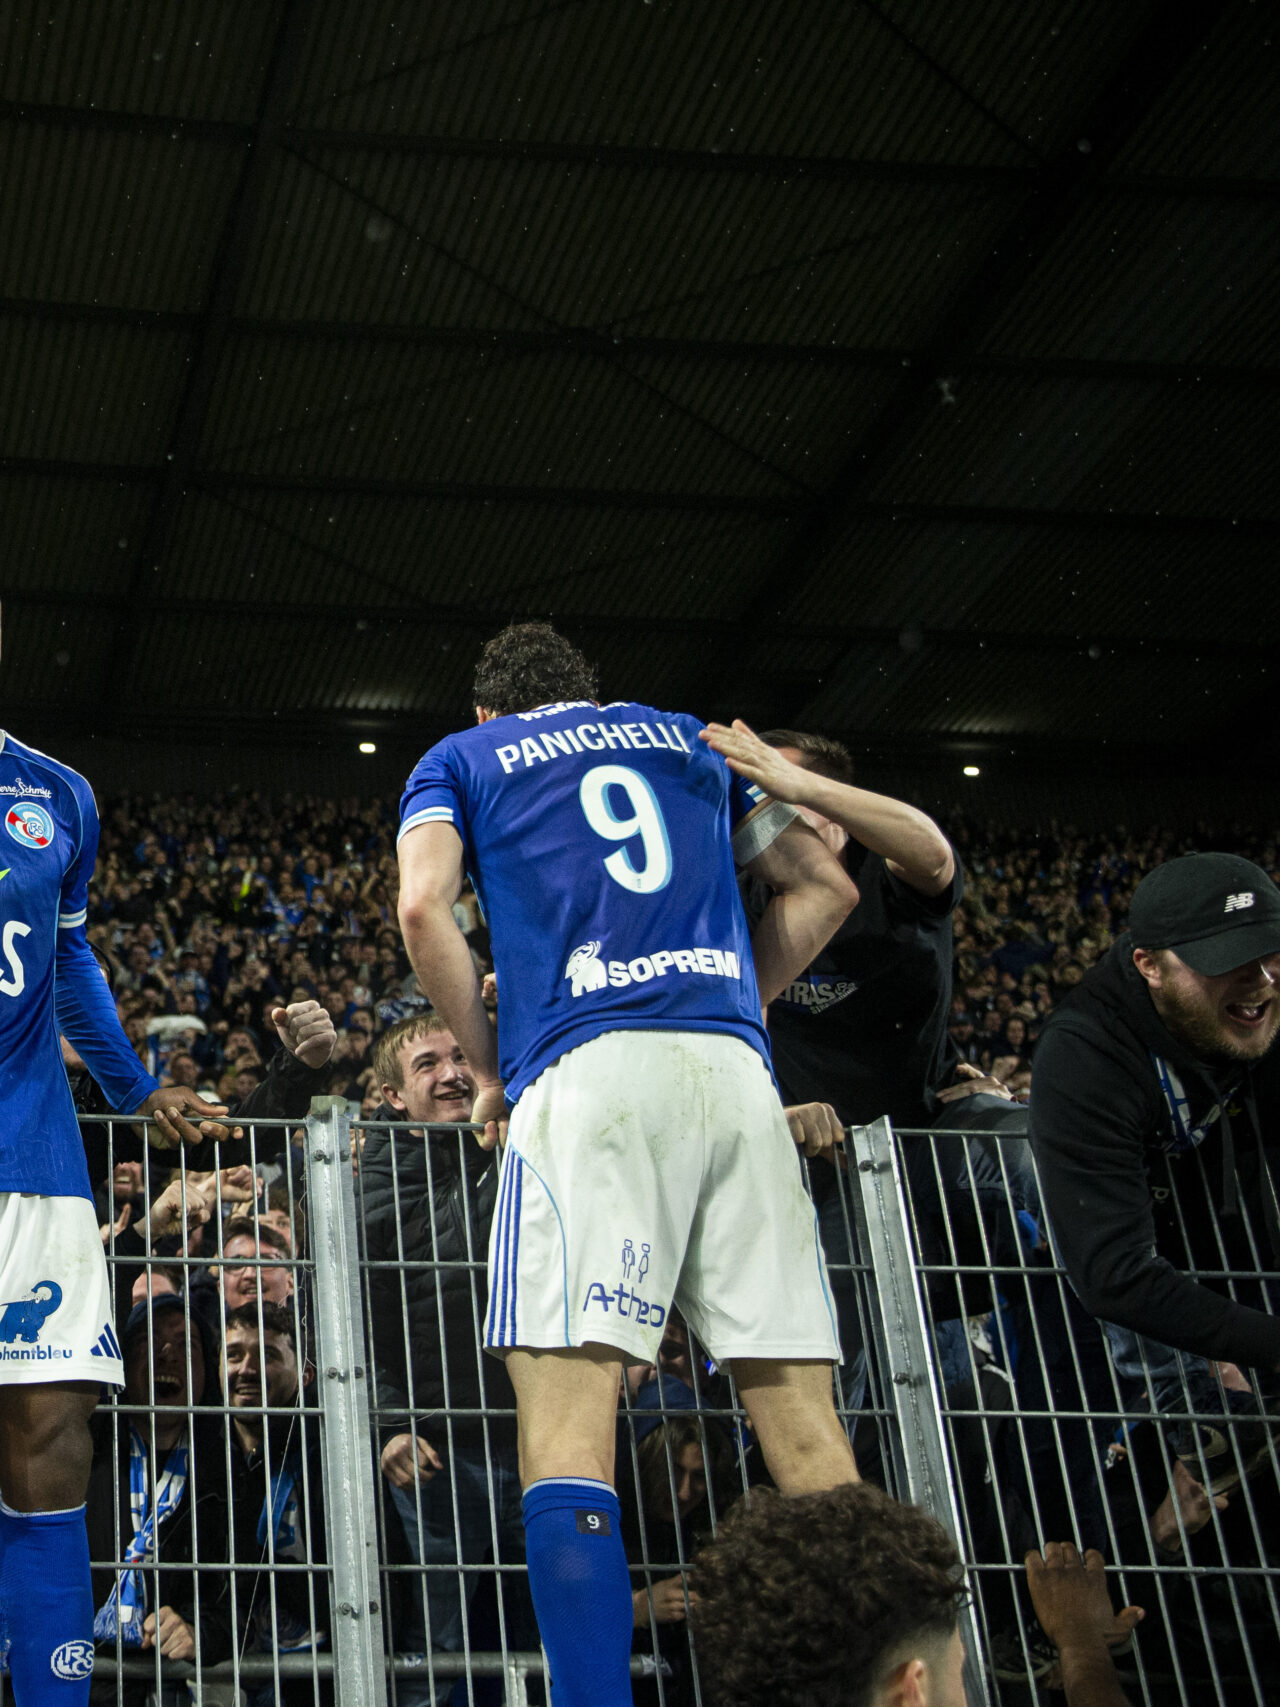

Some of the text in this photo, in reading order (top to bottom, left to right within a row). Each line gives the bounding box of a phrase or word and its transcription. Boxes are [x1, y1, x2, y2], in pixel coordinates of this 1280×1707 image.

[495, 723, 692, 774] PANICHELLI
[579, 765, 673, 894] 9
[608, 947, 741, 988] SOPREM
[780, 980, 836, 1006] TRAS
[586, 1514, 601, 1529] 9
